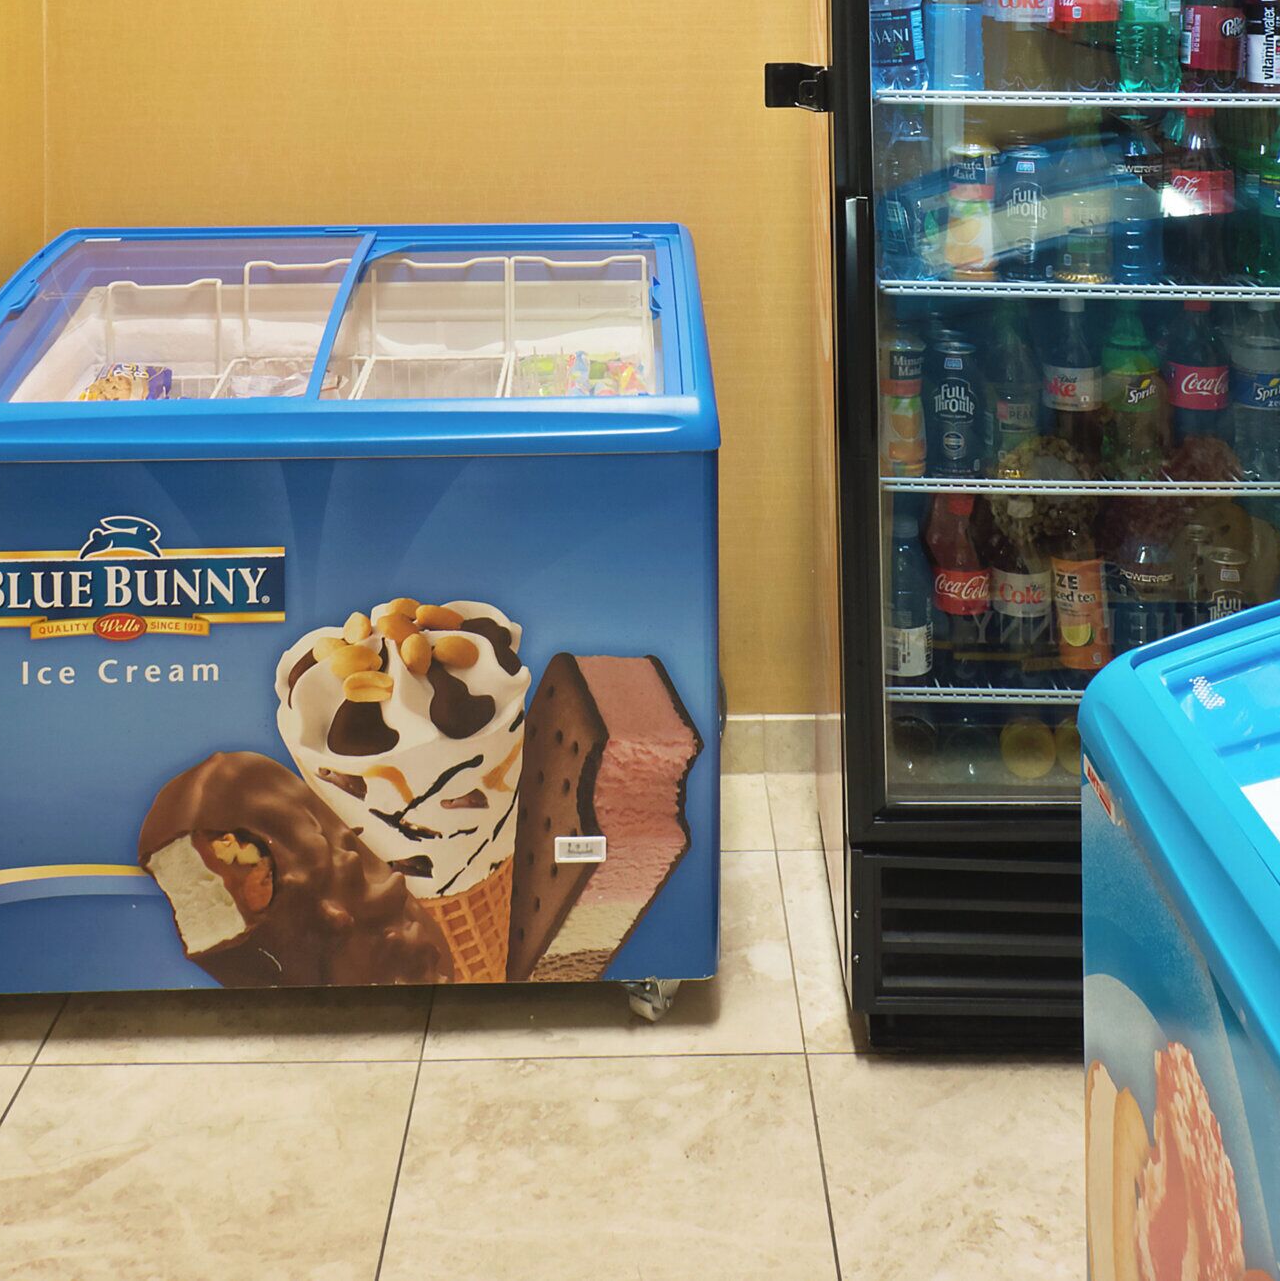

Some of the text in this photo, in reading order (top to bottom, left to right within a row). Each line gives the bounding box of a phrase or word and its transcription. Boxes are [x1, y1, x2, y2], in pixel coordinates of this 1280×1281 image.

[898, 366, 920, 378] Mai
[1128, 386, 1157, 403] Sprite
[935, 573, 990, 600] Coca-Cola
[1056, 573, 1078, 590] ZE
[999, 582, 1046, 605] Coke
[1077, 592, 1097, 603] tea
[39, 617, 204, 634] QUALITY Wells SINCE 1913
[22, 659, 220, 685] Ice Cream
